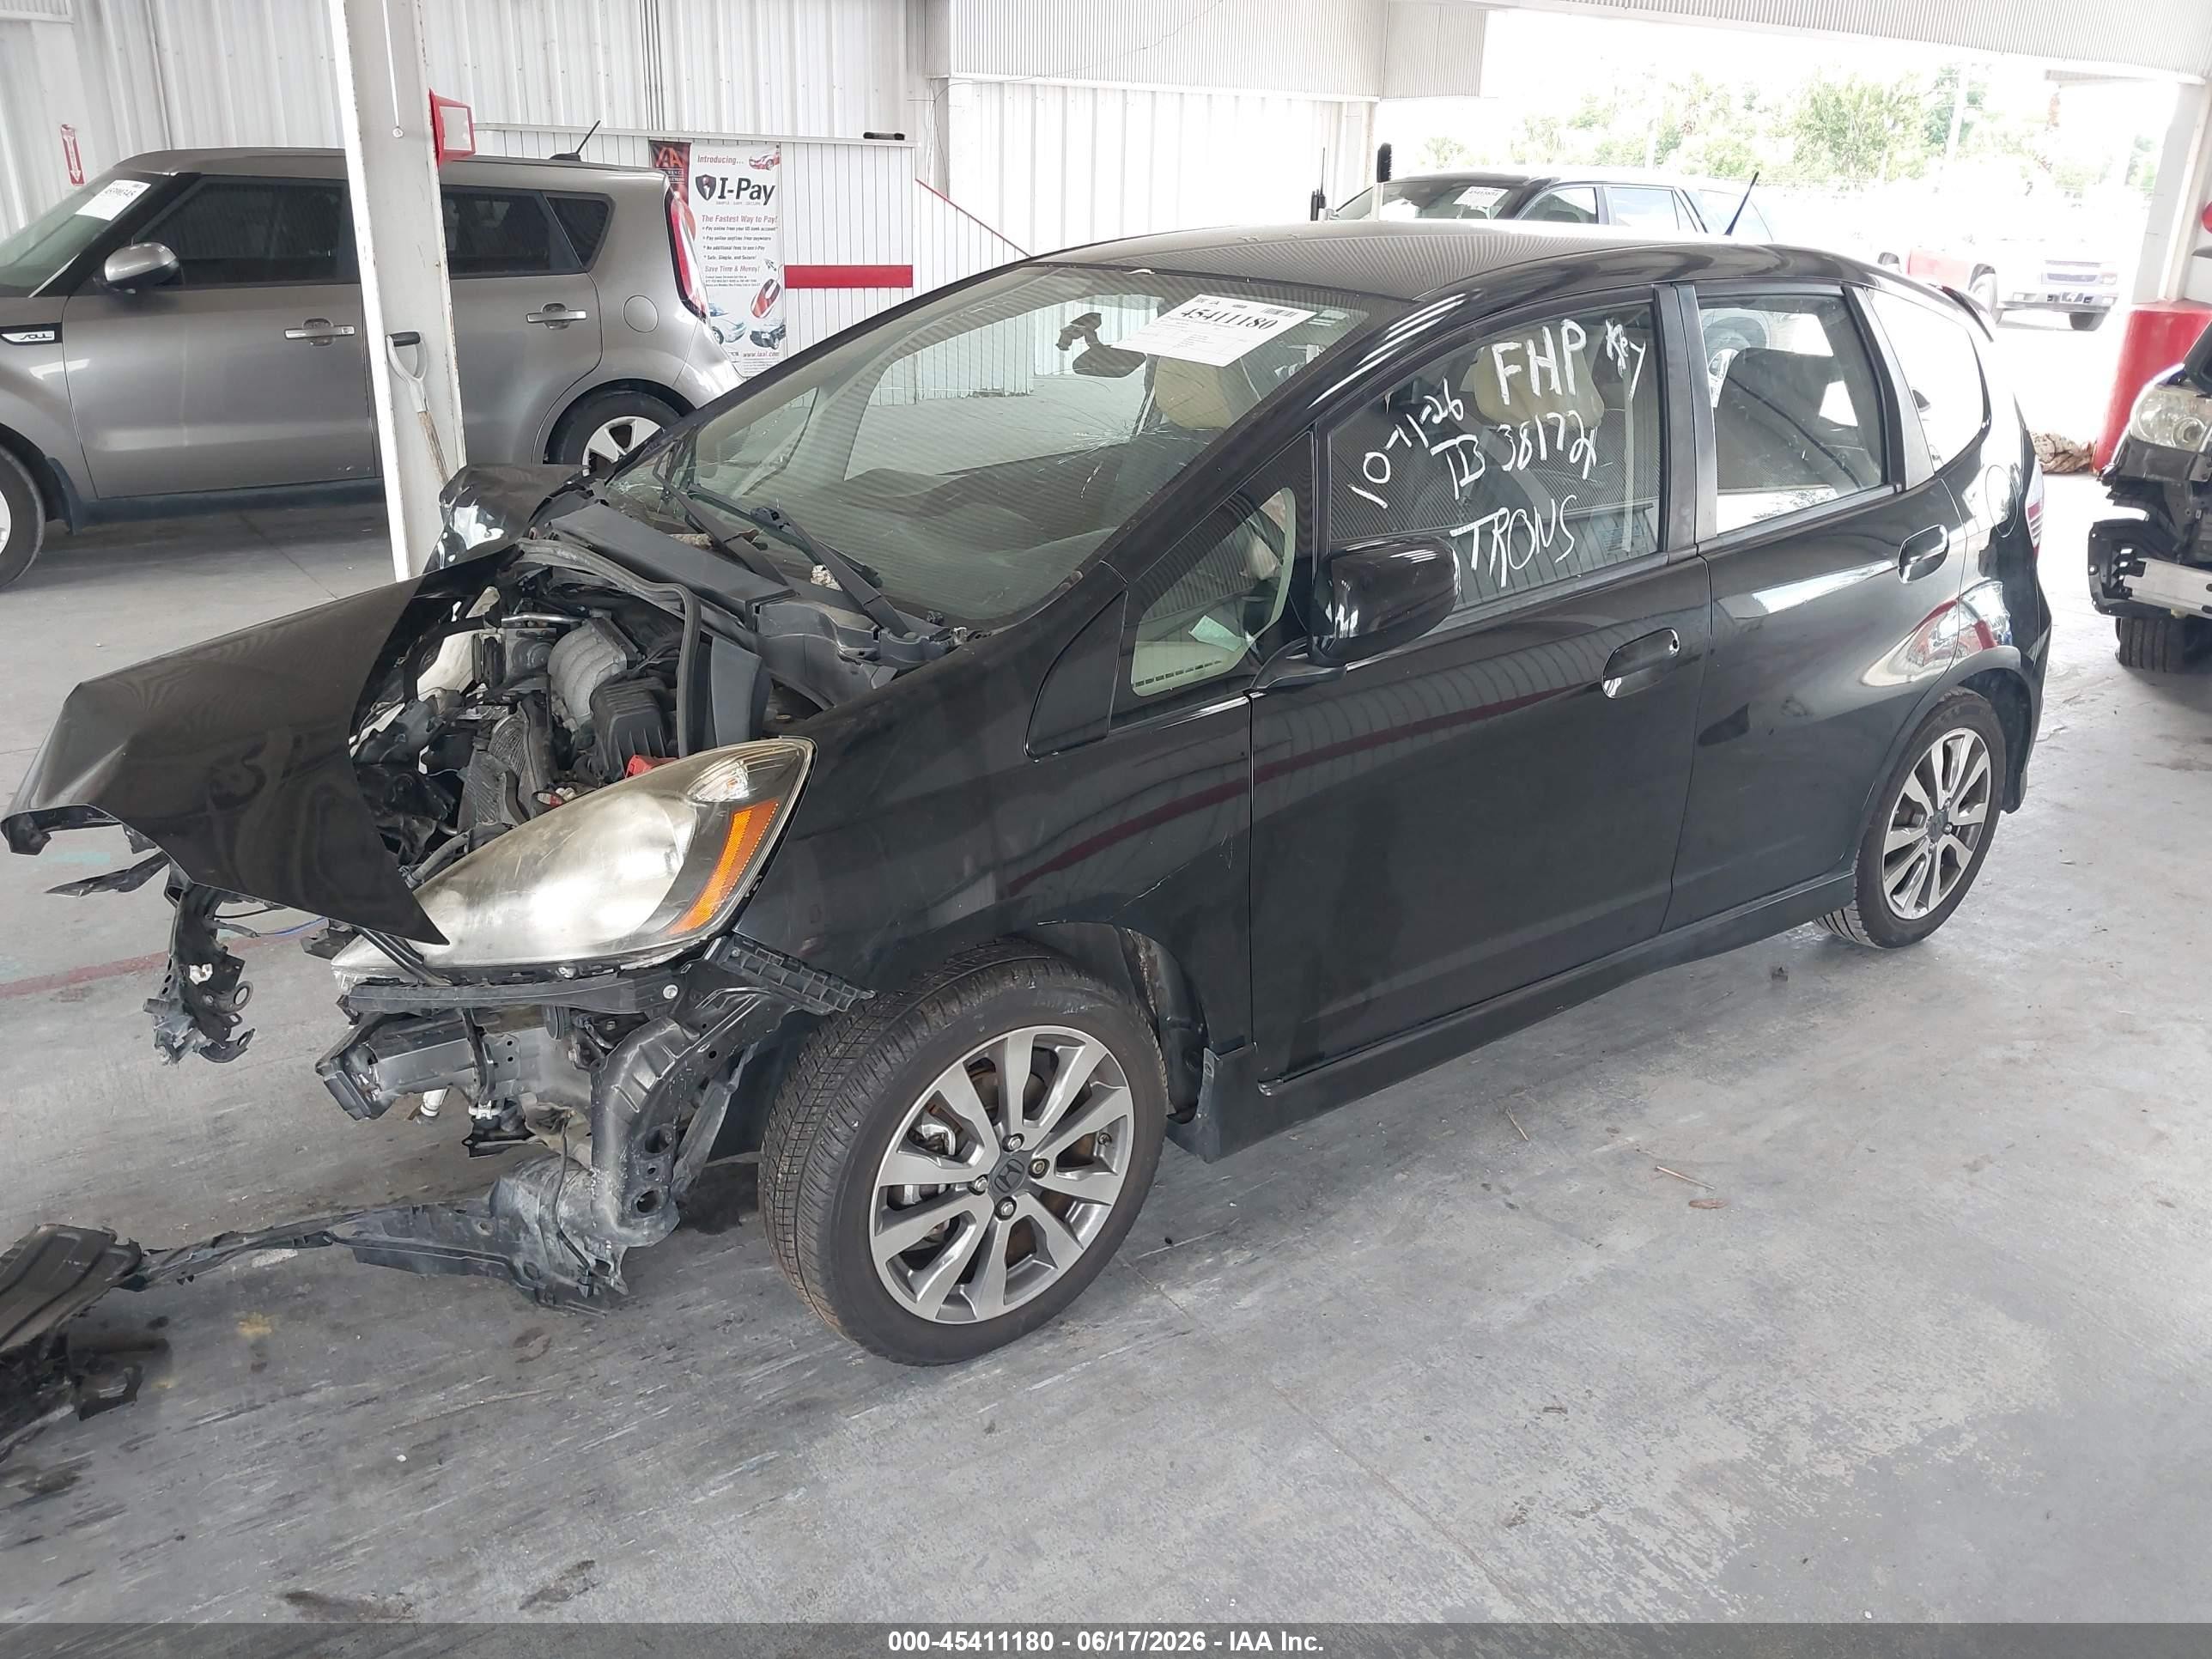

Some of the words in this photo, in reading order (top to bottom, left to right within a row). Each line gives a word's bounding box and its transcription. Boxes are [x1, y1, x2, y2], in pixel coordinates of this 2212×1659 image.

[697, 155, 744, 165] Introducing...
[718, 177, 776, 206] I-Pay
[741, 215, 755, 223] Way
[763, 216, 778, 224] Pay!
[1181, 307, 1279, 331] 45411180
[1491, 319, 1587, 406] FHP
